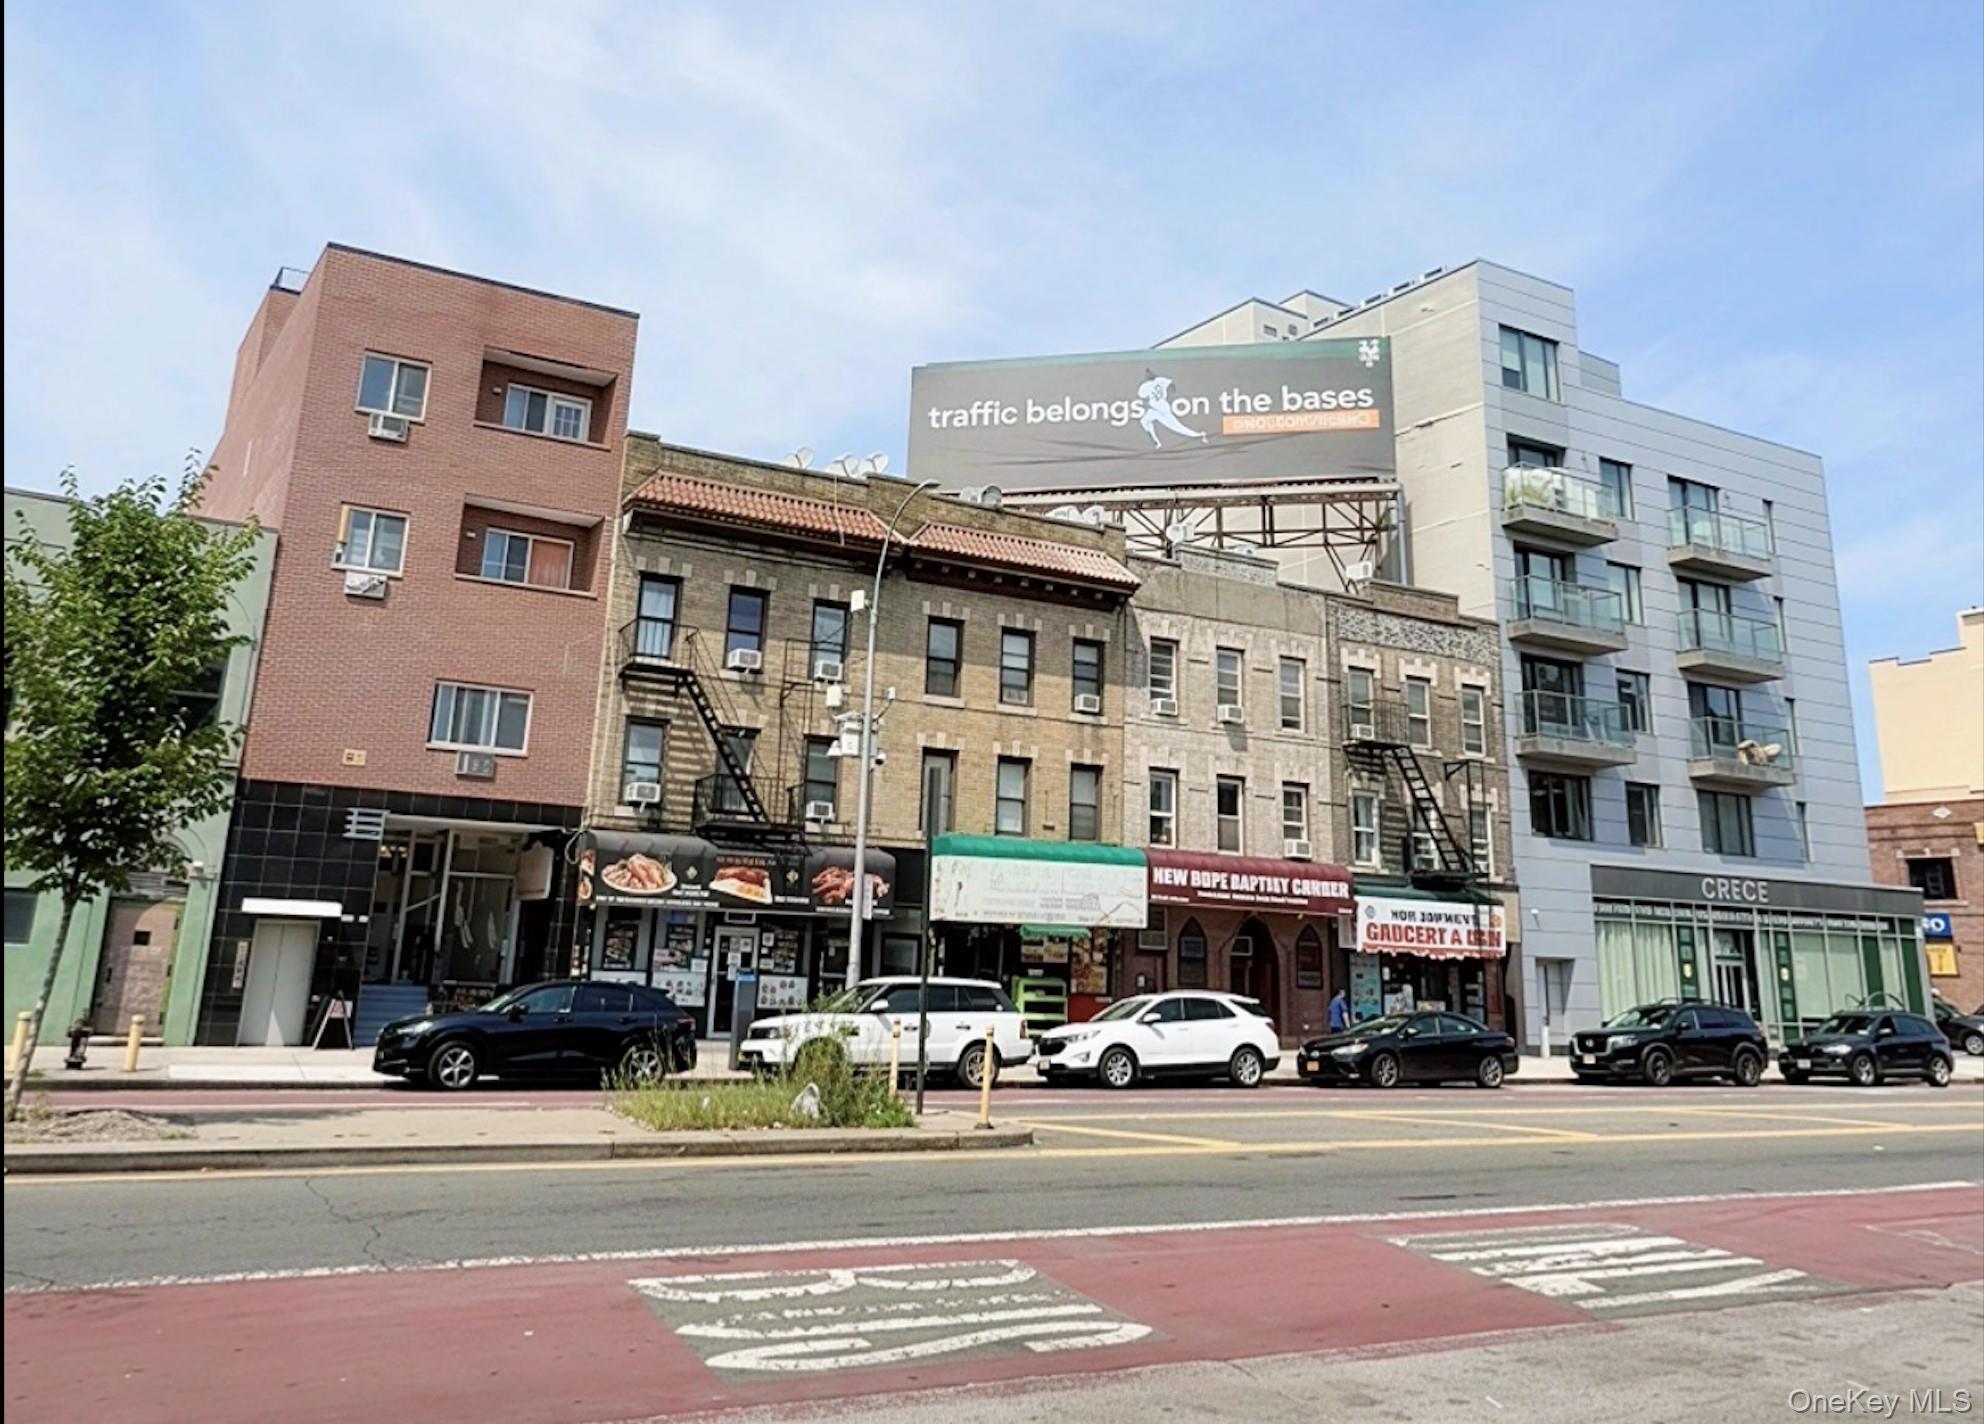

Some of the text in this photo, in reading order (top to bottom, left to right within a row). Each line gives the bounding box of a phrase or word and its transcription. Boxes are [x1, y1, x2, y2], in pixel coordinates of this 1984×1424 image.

[928, 385, 1375, 428] traffic belongs on the bases
[1701, 877, 1769, 903] CRECE
